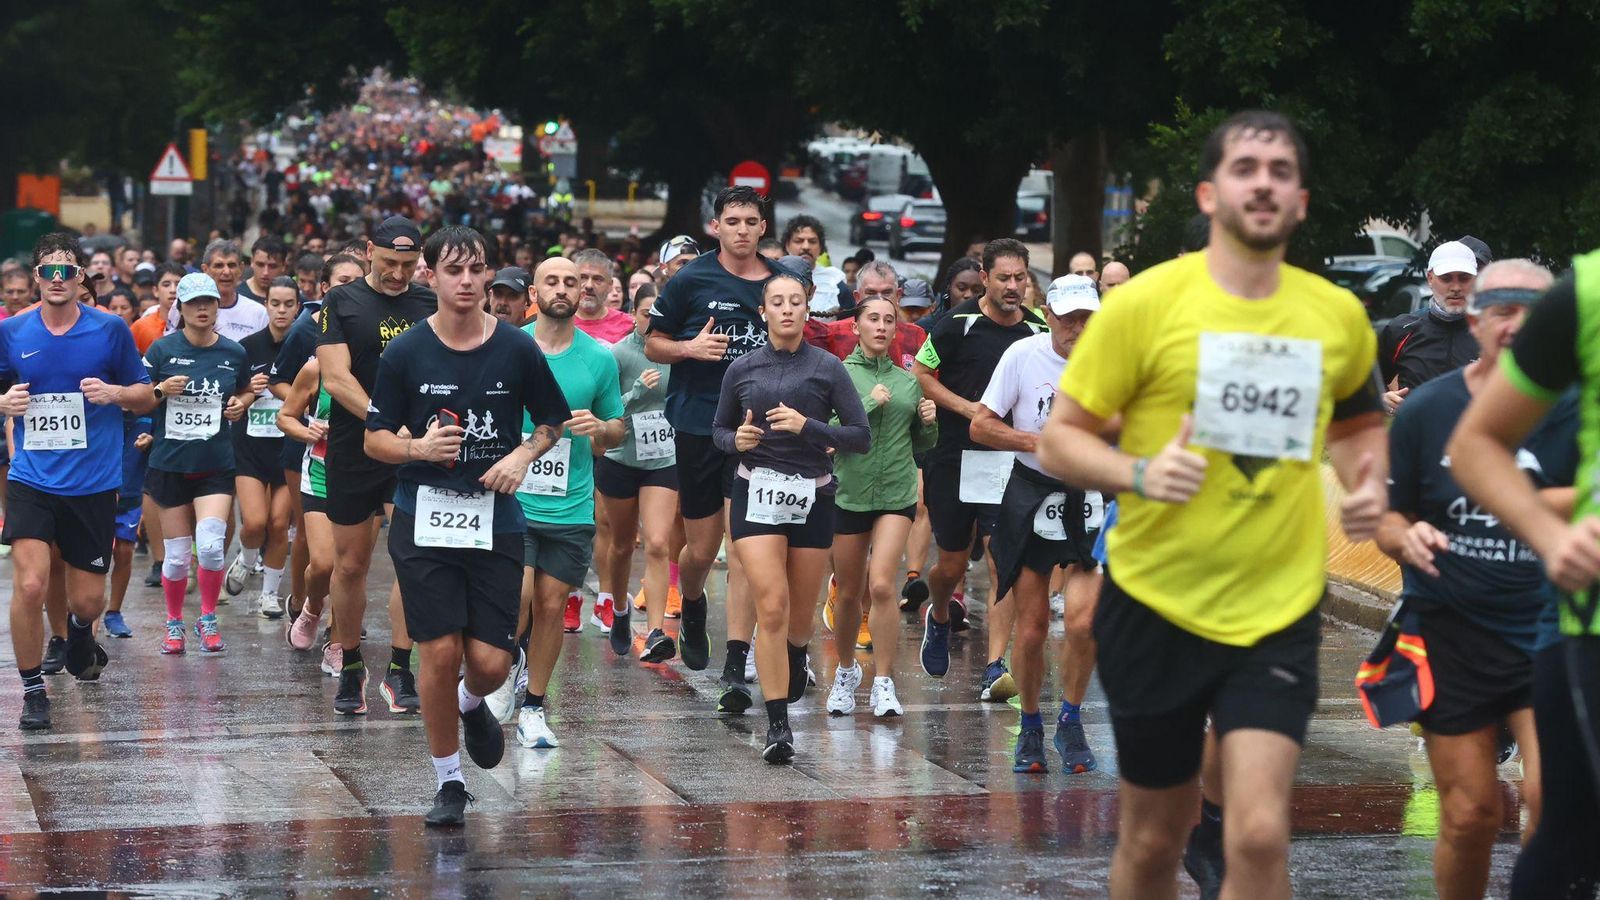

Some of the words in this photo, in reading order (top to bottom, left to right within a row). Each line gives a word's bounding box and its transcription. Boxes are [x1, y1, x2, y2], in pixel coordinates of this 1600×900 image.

[1221, 382, 1302, 418] 6942
[30, 415, 81, 431] 12510
[174, 412, 212, 427] 3554
[252, 412, 279, 425] 214
[756, 488, 808, 510] 11304
[429, 511, 480, 531] 5224
